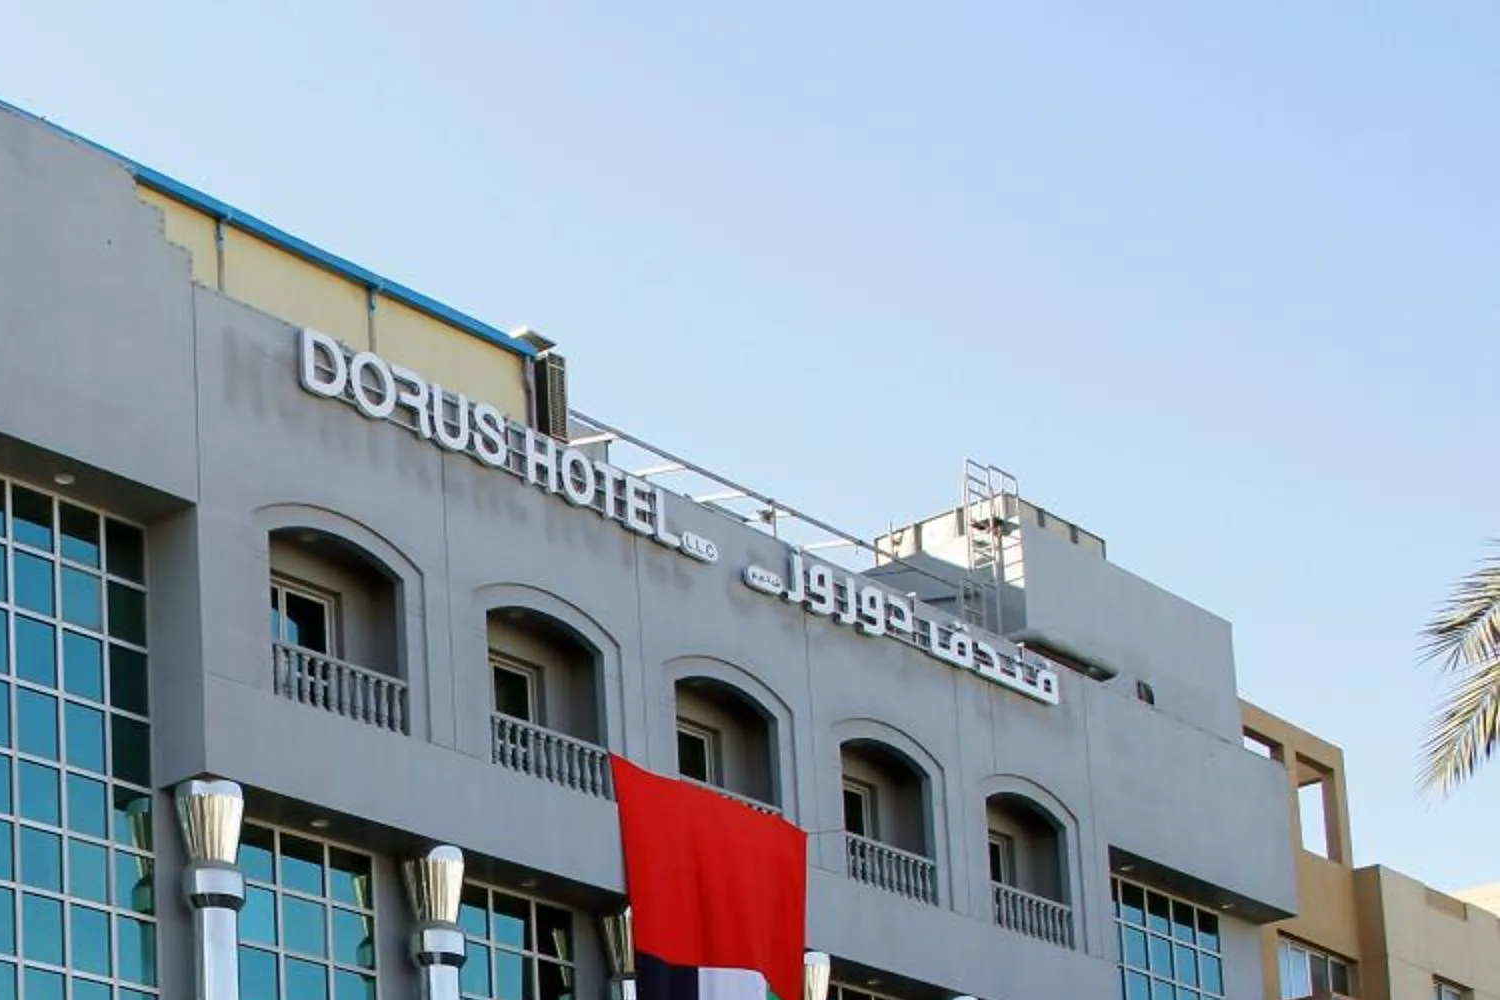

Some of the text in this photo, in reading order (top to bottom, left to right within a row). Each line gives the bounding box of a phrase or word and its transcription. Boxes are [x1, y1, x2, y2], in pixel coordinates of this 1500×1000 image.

[301, 327, 507, 467] DORUS
[525, 430, 682, 547] HOTEL
[930, 622, 1060, 705] فندق
